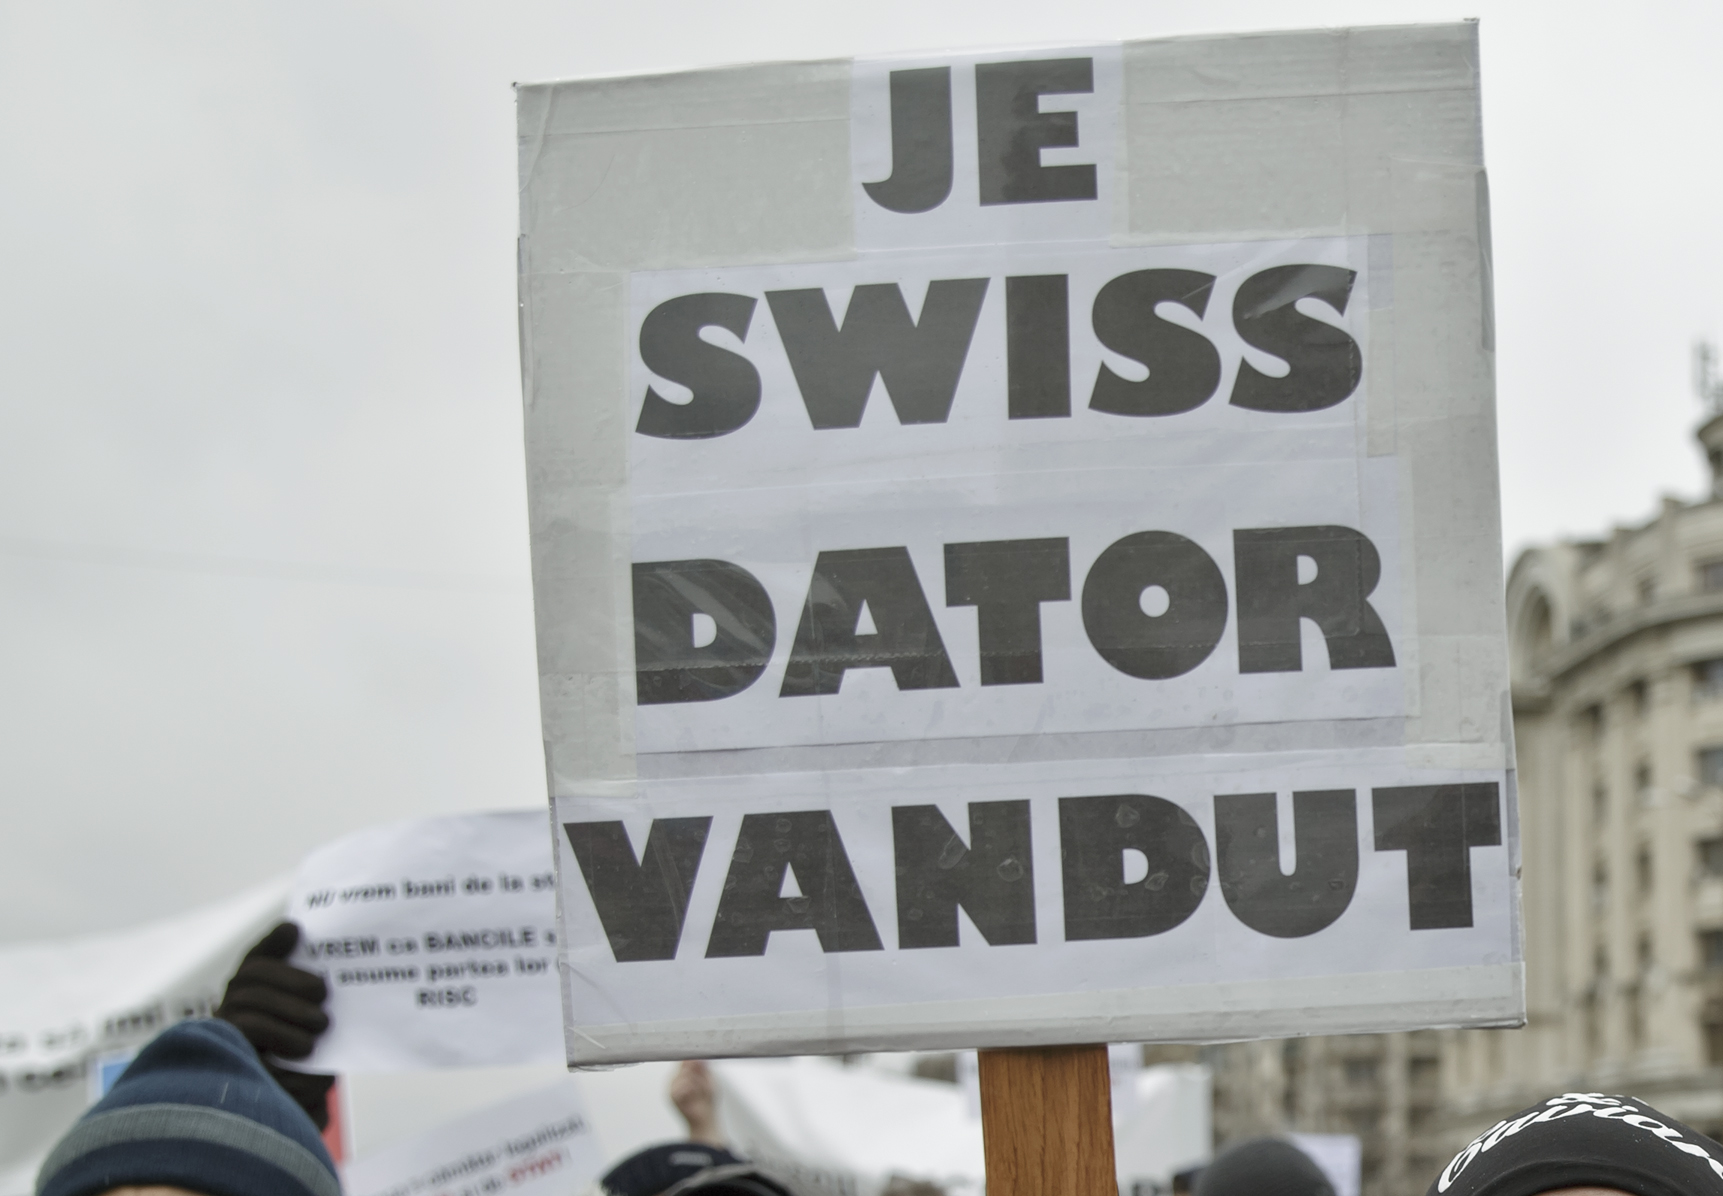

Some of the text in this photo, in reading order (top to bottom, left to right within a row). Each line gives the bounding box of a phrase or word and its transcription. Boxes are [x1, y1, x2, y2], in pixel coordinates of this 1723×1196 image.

[863, 57, 1098, 213] JE
[635, 264, 1363, 440] SWISS
[631, 525, 1397, 706] DATOR
[401, 876, 455, 898] bani
[461, 874, 492, 894] de
[499, 873, 523, 893] la
[424, 926, 538, 950] BANCILE
[562, 782, 1503, 963] VANDUT
[416, 985, 477, 1009] RISC
